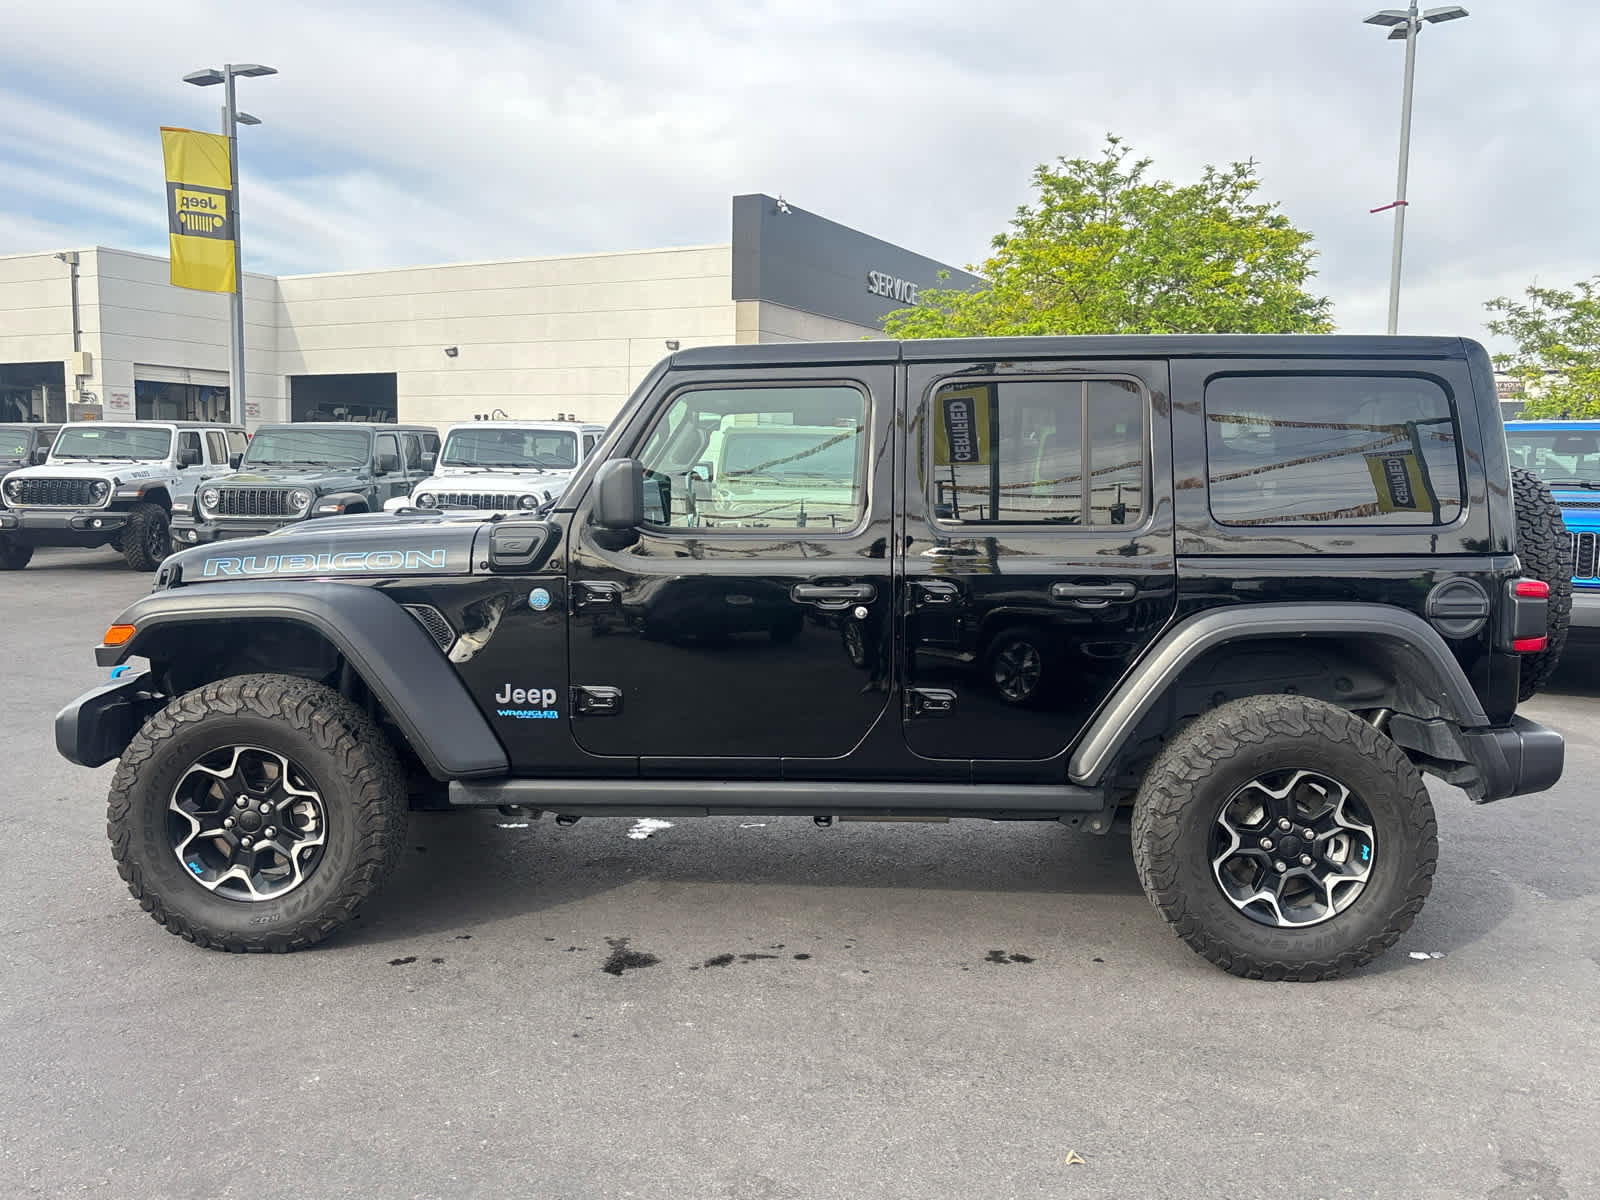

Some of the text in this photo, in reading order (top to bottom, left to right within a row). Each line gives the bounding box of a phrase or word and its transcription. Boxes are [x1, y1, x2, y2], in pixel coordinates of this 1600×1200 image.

[868, 270, 918, 305] SERVICE
[203, 549, 446, 576] RUBICON
[495, 683, 557, 708] Jeep
[497, 709, 559, 717] WRANGLER
